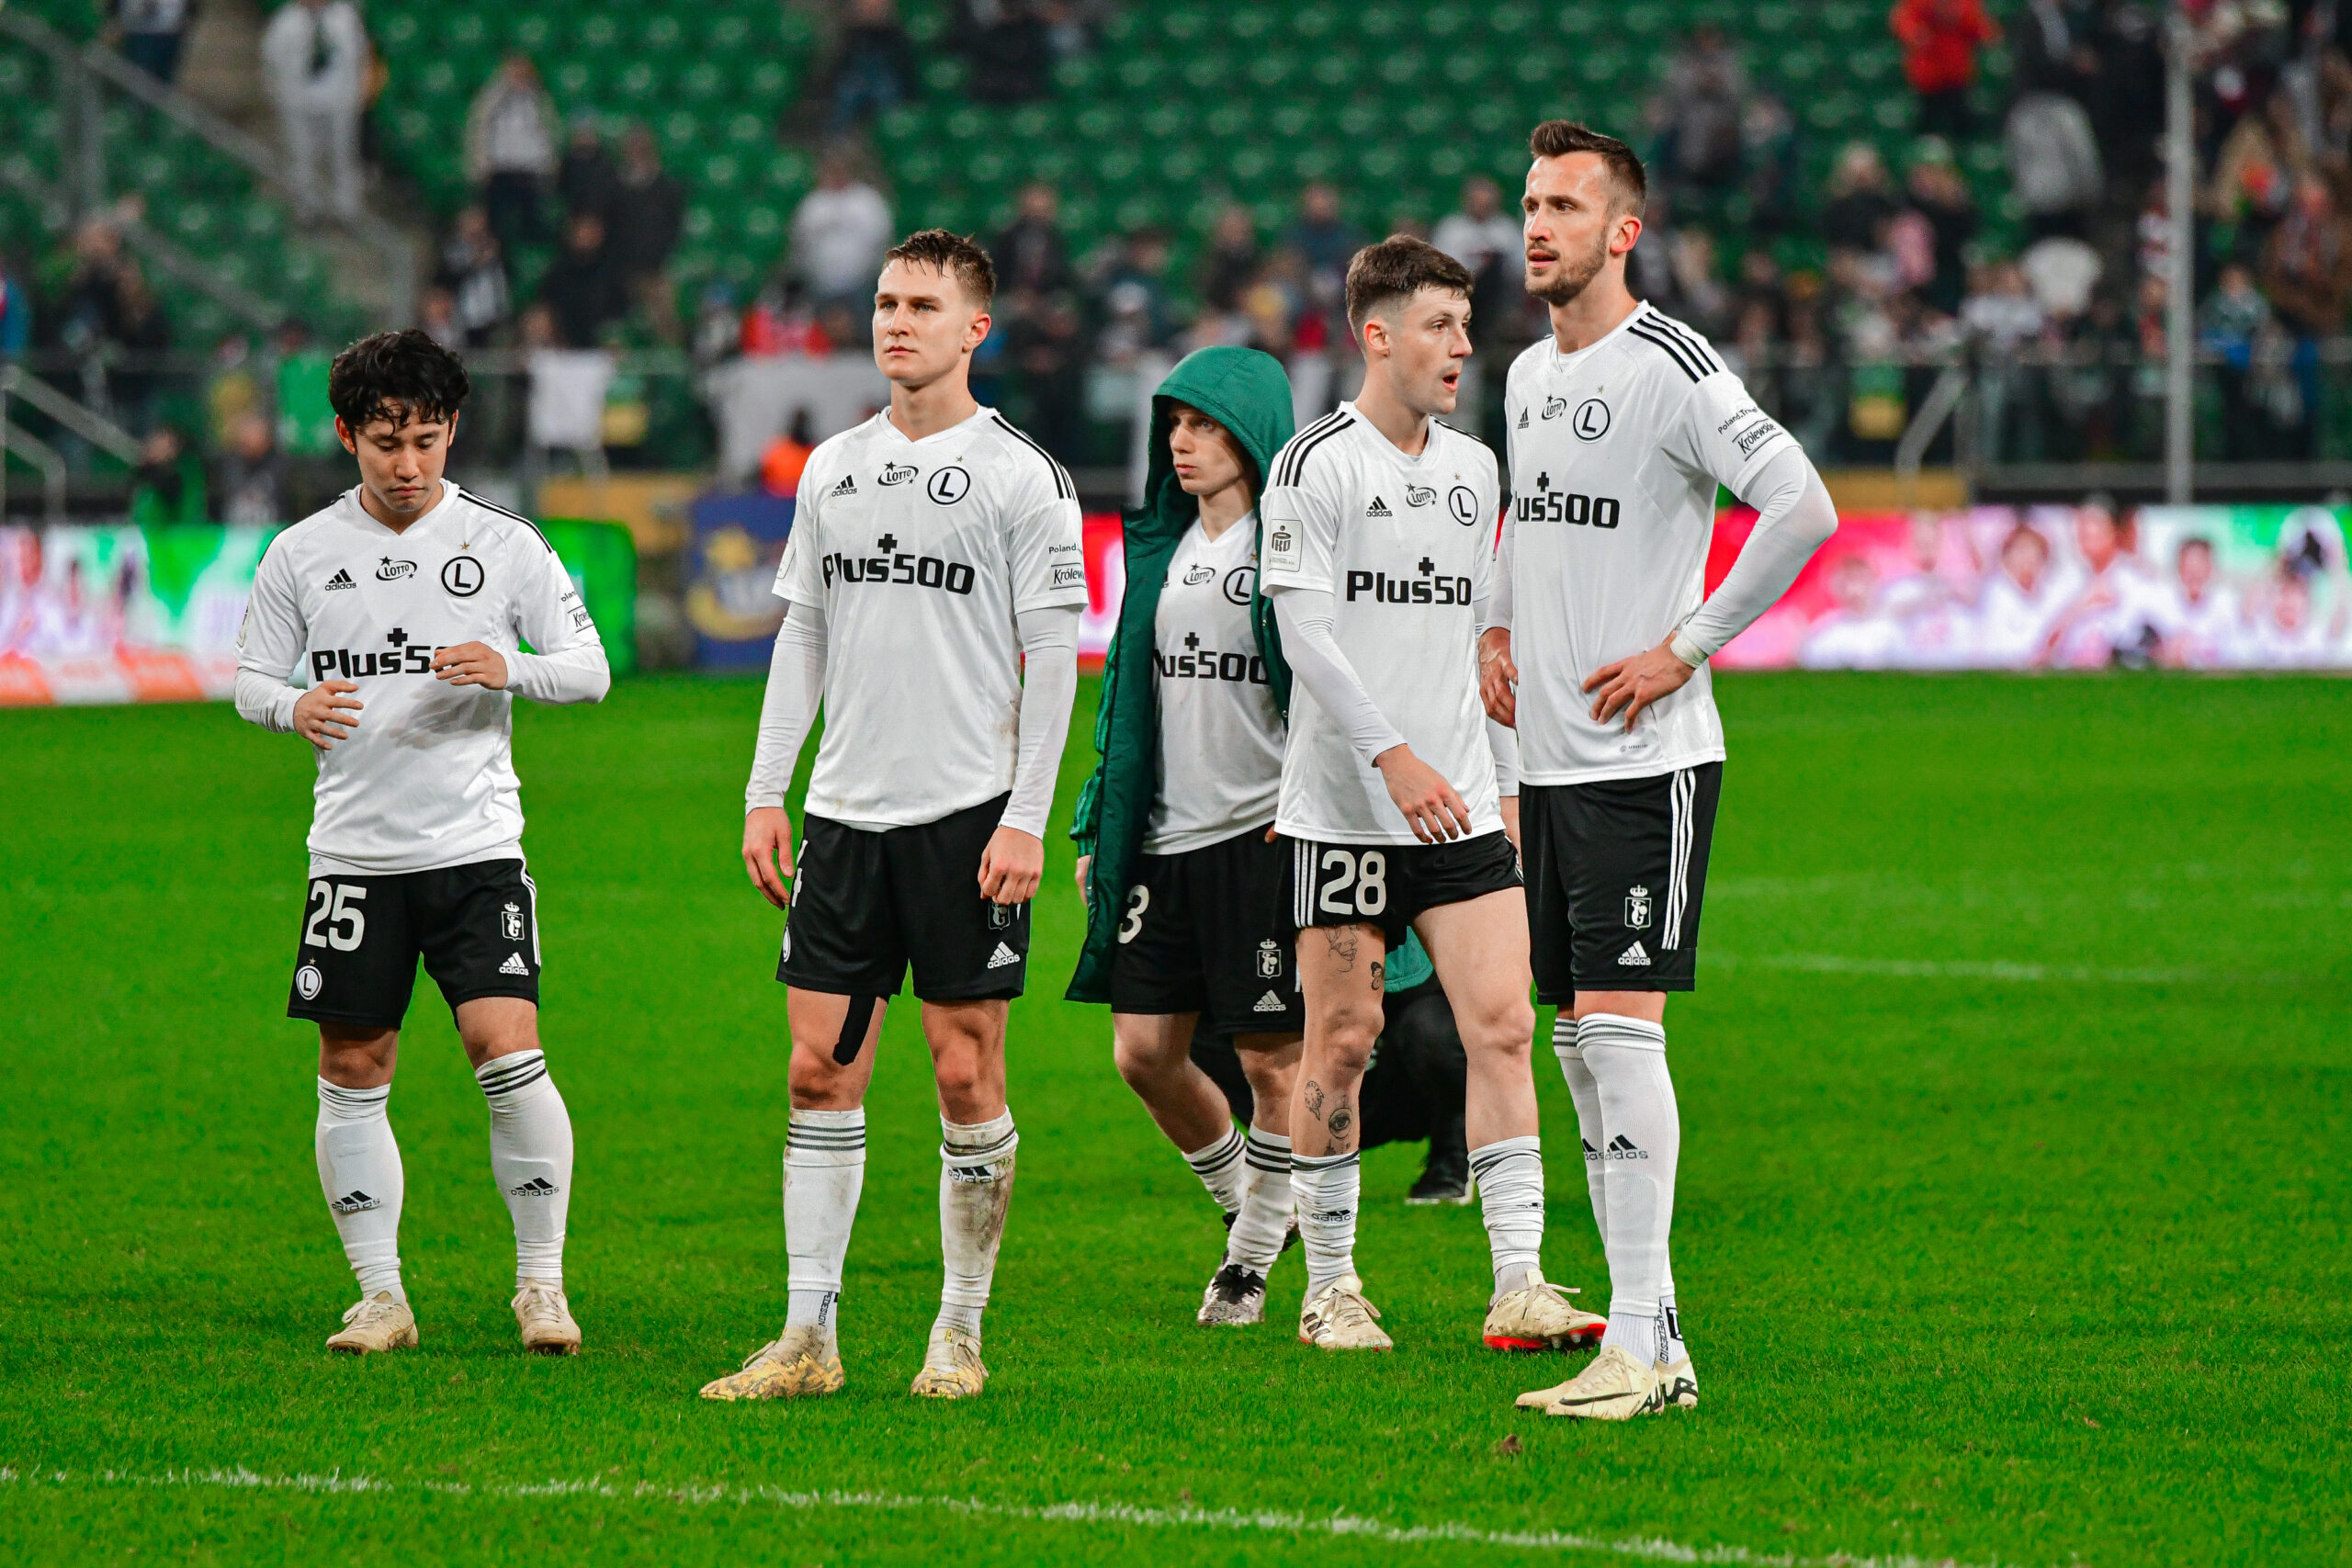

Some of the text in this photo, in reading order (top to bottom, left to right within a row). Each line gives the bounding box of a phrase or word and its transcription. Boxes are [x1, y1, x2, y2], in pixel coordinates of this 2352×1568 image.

[1582, 406, 1597, 434] L
[887, 469, 911, 482] LOTTO
[937, 472, 955, 499] L
[831, 487, 858, 498] adidas
[1411, 491, 1431, 503] LOTTO
[1456, 493, 1473, 518] L
[1515, 491, 1621, 530] us500
[1366, 509, 1394, 518] adidas
[384, 564, 410, 577] LOTTO
[454, 563, 471, 589] L
[822, 552, 976, 595] Plus500
[1190, 570, 1210, 582] LOTTO
[324, 581, 357, 592] adidas
[1234, 572, 1250, 599] L
[1318, 850, 1387, 916] 28
[305, 880, 367, 952] 25
[988, 953, 1021, 969] adidas
[1617, 956, 1652, 966] adidas
[499, 965, 529, 976] adidas
[303, 973, 312, 992] L
[1253, 1003, 1287, 1012] adidas
[511, 1186, 560, 1197] adidas
[331, 1198, 380, 1212] adidas
[1311, 1211, 1356, 1223] adidas
